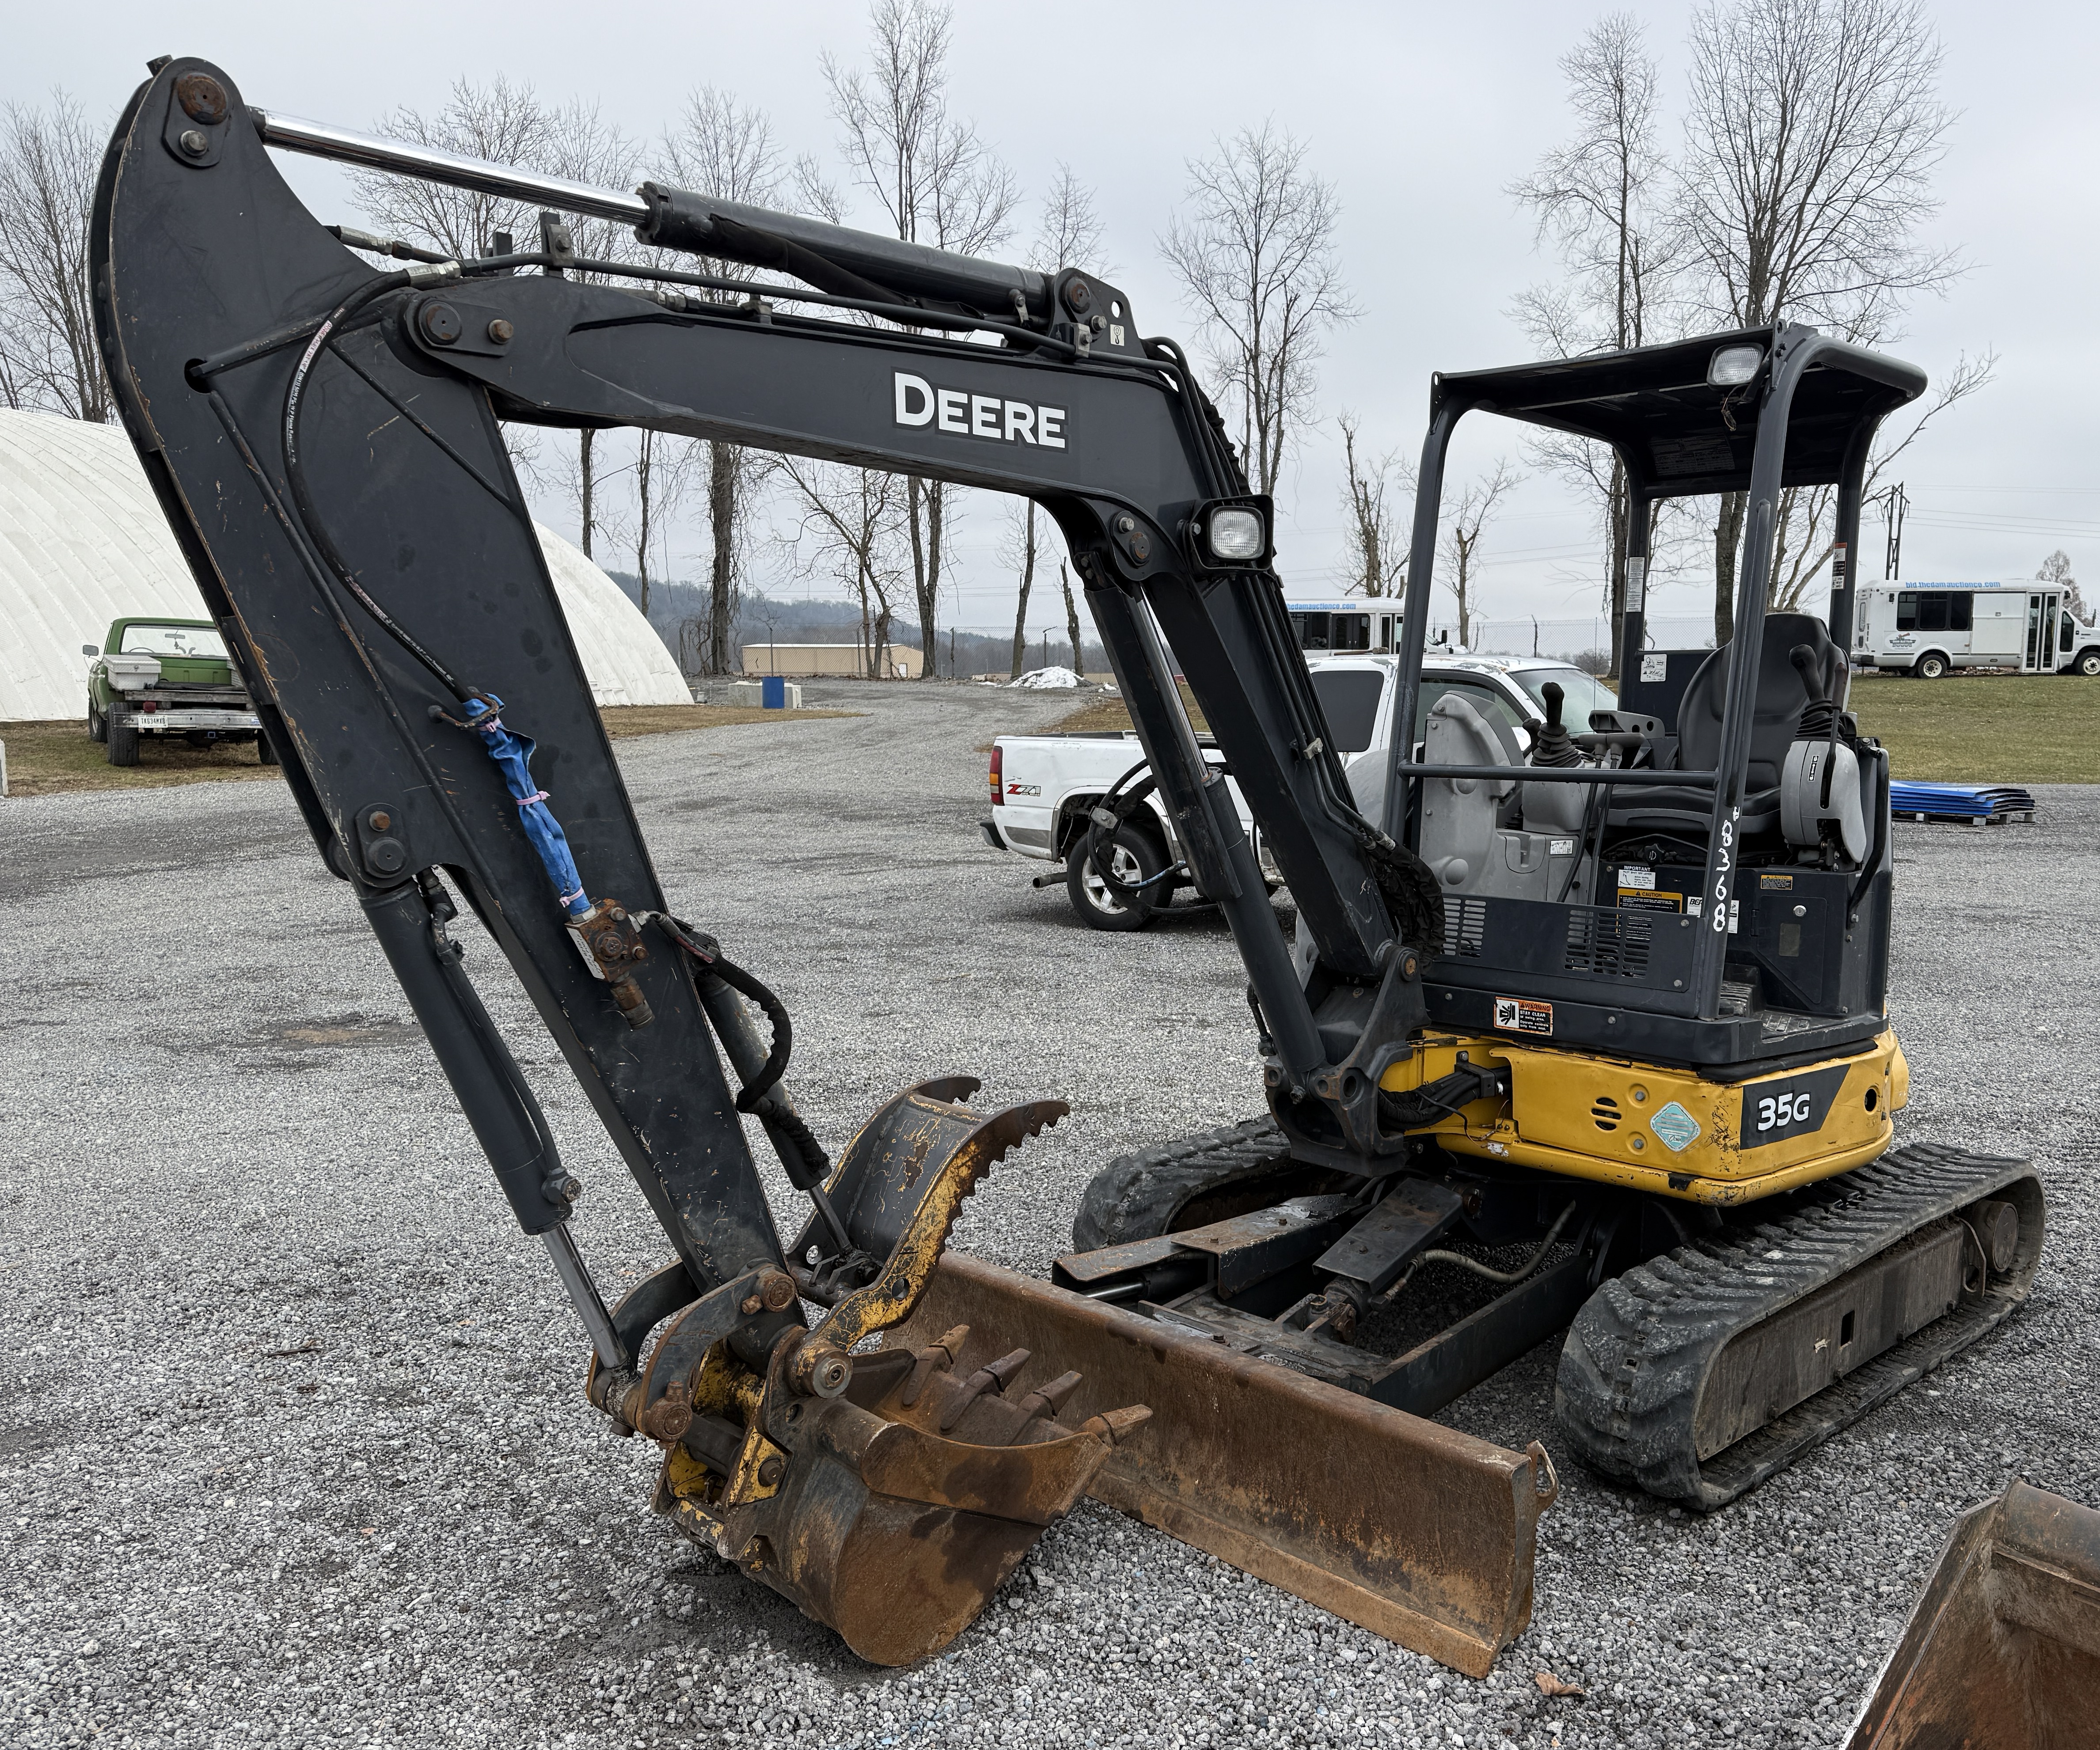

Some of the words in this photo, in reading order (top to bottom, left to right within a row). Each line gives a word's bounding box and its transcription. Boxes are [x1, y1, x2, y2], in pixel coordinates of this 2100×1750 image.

[895, 372, 1065, 448] DEERE
[1006, 784, 1041, 795] Z71
[1525, 1003, 1550, 1012] WARNING
[1758, 1093, 1810, 1131] 35G
